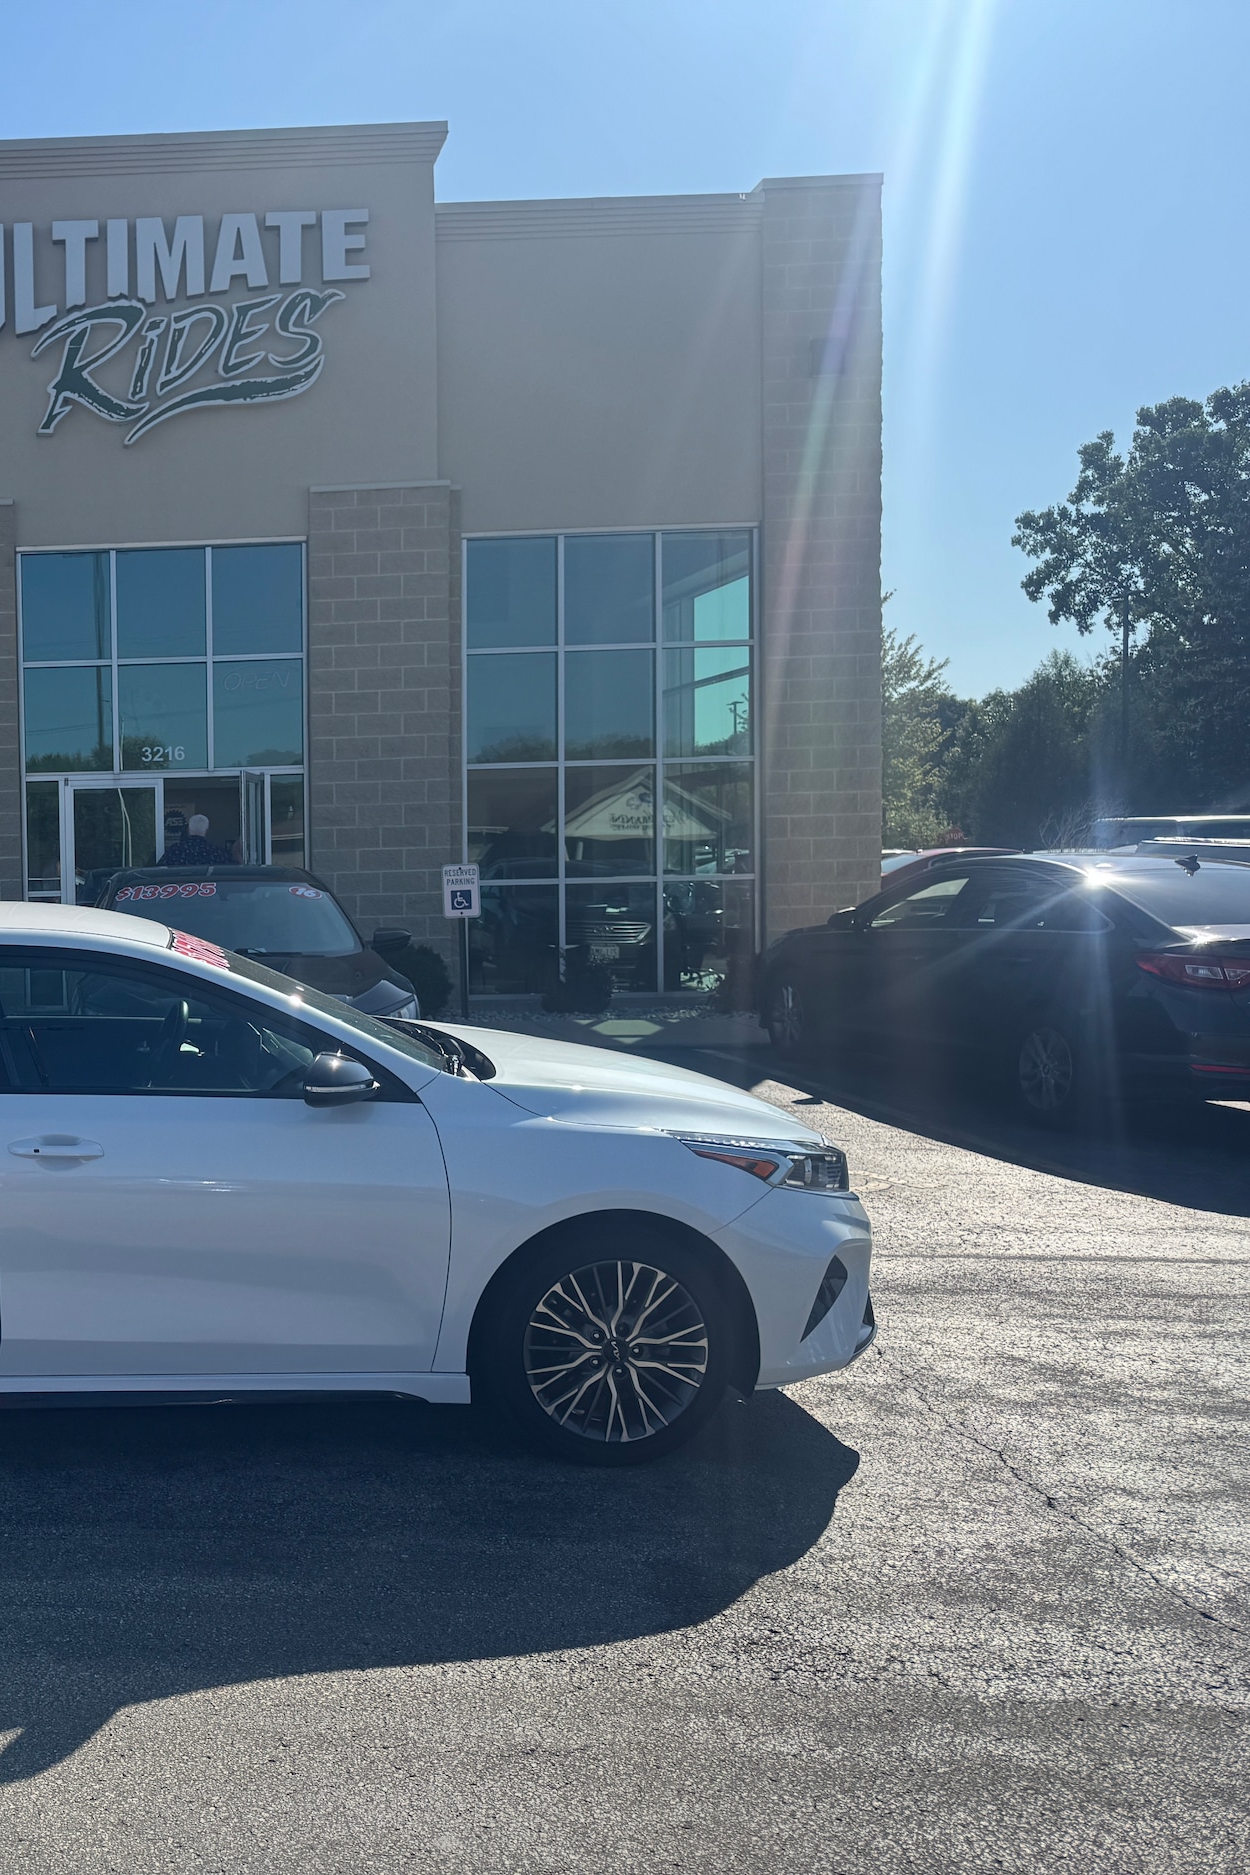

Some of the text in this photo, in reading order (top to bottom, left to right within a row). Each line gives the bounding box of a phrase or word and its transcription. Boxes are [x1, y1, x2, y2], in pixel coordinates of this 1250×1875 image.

[141, 746, 186, 762] 3216
[444, 869, 477, 877] RESERVED
[446, 878, 475, 886] PARKING
[116, 882, 217, 901] $13995
